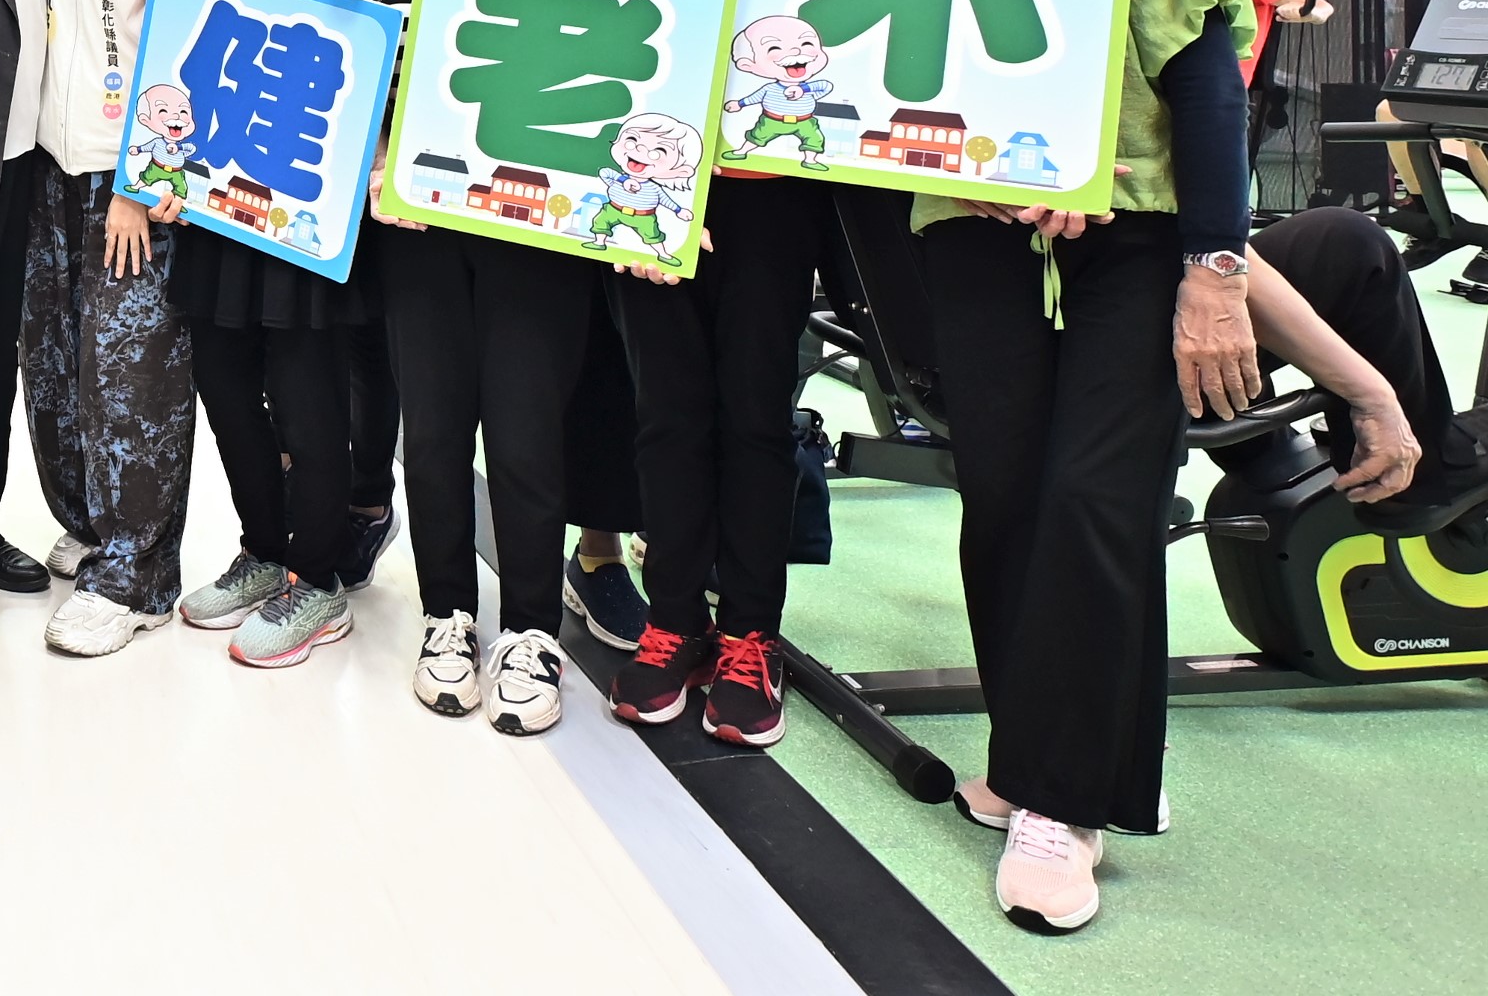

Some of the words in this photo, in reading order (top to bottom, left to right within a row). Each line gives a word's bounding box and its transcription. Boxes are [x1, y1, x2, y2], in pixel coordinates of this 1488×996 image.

[101, 0, 119, 67] 彰化縣議員
[179, 0, 346, 202] 健
[1398, 638, 1450, 651] CHANSON
